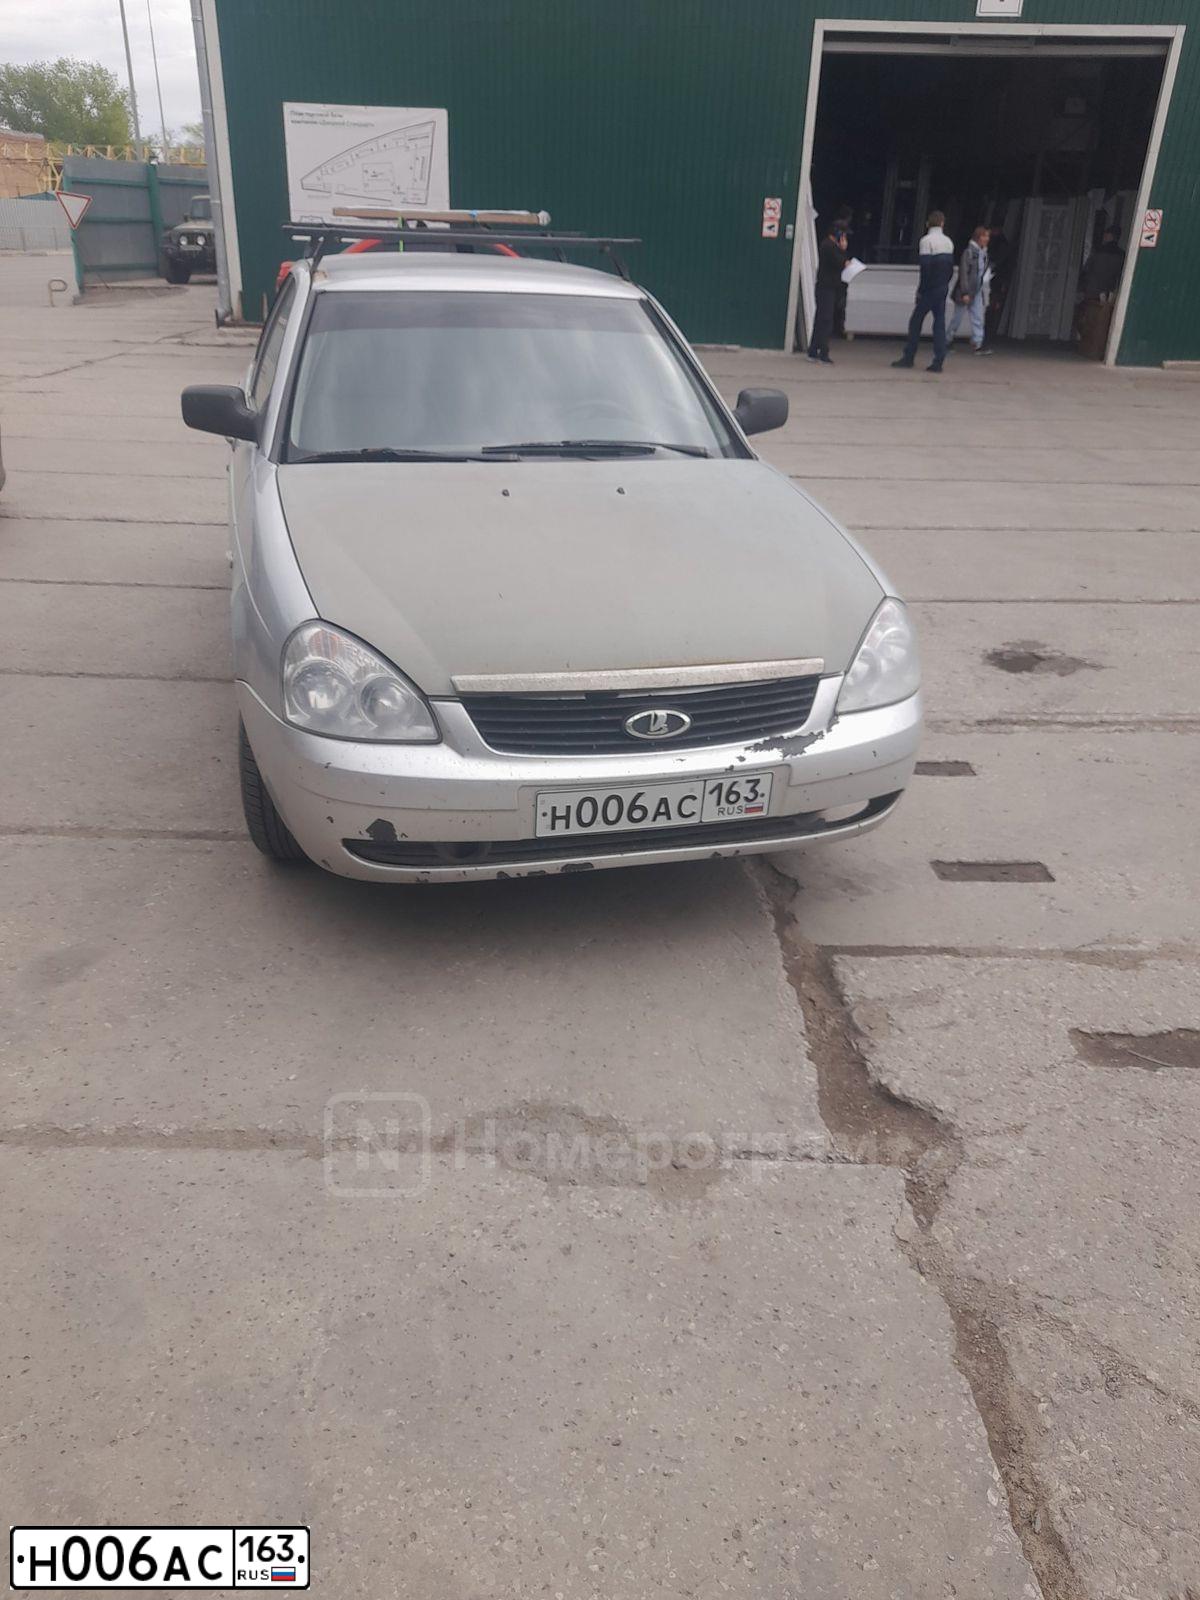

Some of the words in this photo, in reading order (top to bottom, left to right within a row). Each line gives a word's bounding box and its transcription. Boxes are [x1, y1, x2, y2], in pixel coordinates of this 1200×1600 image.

[708, 778, 761, 806] 163
[550, 792, 697, 831] Н006АС
[717, 805, 743, 817] RUS
